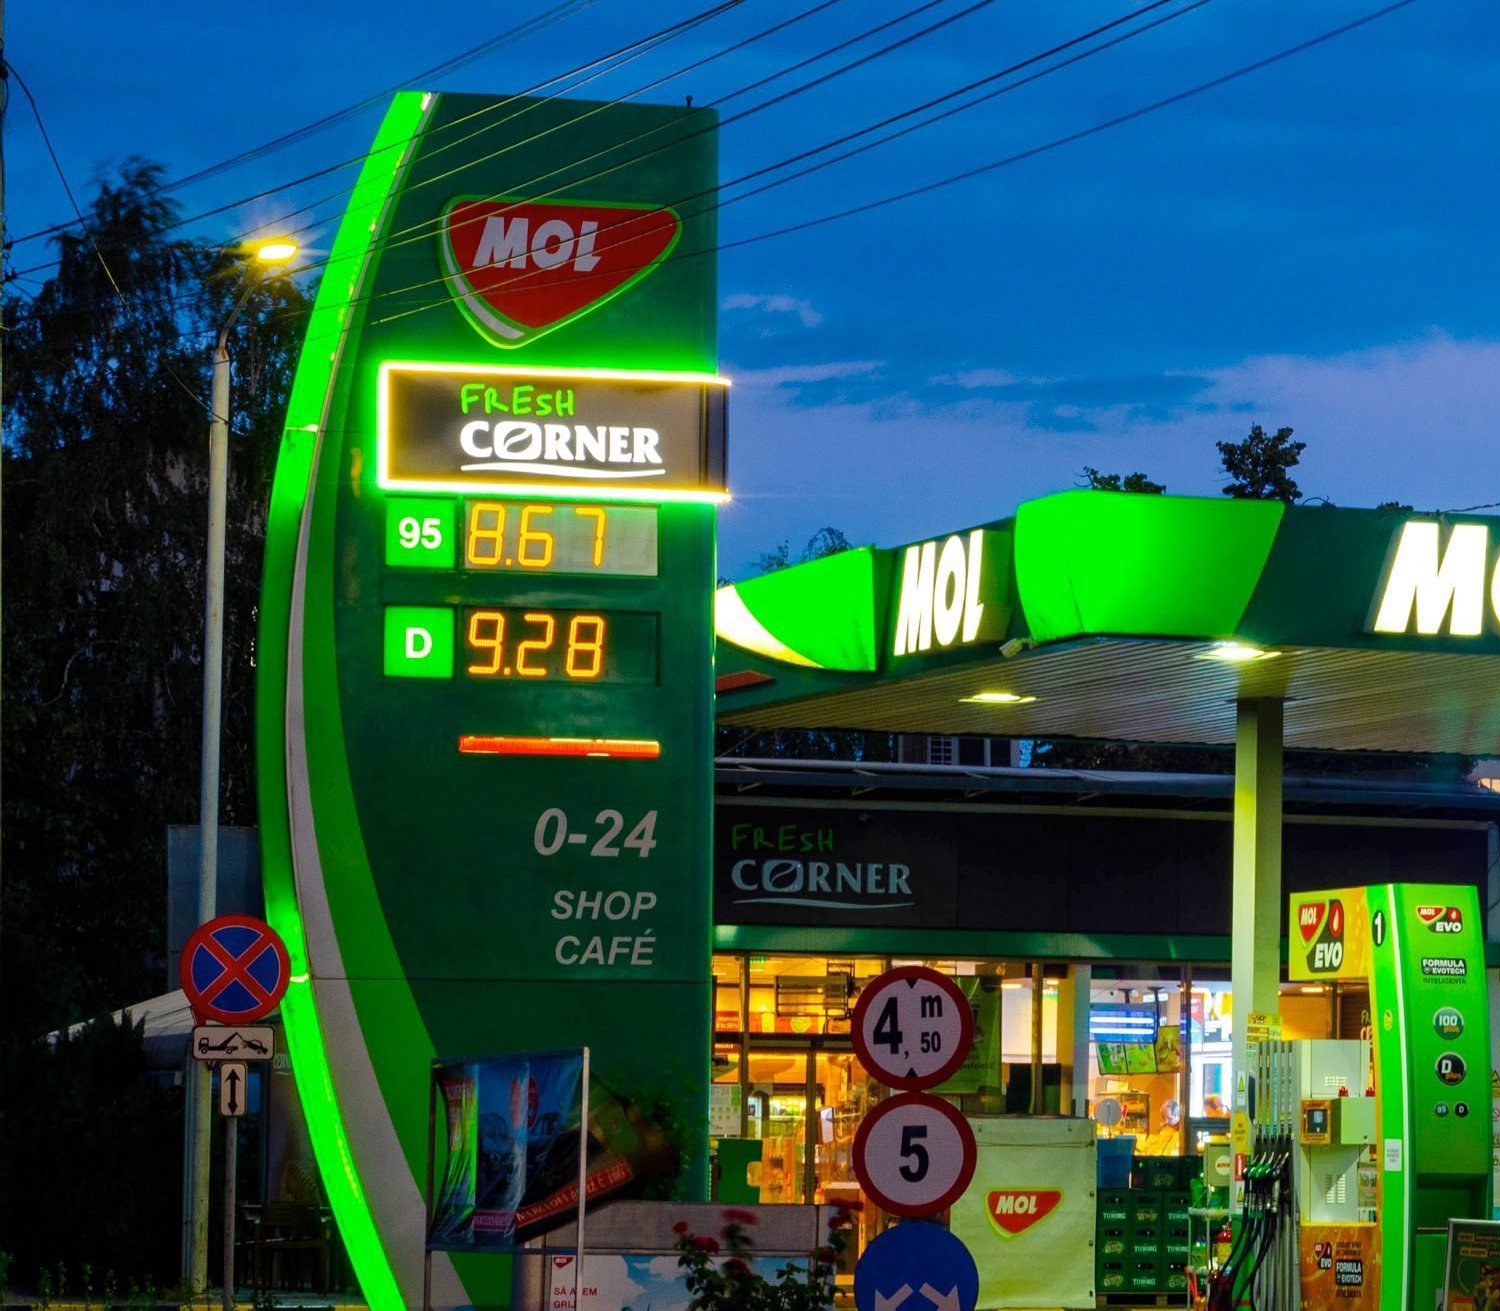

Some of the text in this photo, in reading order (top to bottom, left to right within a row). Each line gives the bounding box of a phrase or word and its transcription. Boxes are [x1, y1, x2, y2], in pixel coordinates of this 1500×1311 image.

[472, 215, 602, 272] MOL
[461, 383, 575, 417] FRESH
[460, 420, 663, 464] CORNER
[398, 517, 442, 550] 95
[467, 502, 608, 567] 8.67
[893, 529, 986, 656] MOL
[405, 627, 433, 659] D
[468, 611, 605, 678] 9.28
[534, 807, 658, 858] 0-24
[731, 823, 834, 853] FRESH
[731, 858, 912, 895] CORNER
[551, 890, 657, 920] SHOP
[1300, 907, 1317, 926] MOL
[1420, 907, 1436, 916] MOL
[1374, 911, 1382, 945] 1
[1435, 921, 1462, 932] EVO
[555, 928, 656, 966] CAFÉ
[1314, 942, 1343, 969] EVO
[1422, 958, 1464, 968] FORMULA
[1432, 967, 1466, 975] EVOTECH
[1439, 1015, 1458, 1026] 100
[1441, 1060, 1452, 1074] D
[1458, 1105, 1465, 1114] D
[898, 1125, 930, 1184] 5
[995, 1195, 1038, 1215] MOL
[1103, 1212, 1126, 1220] TUBORG
[1320, 1258, 1332, 1268] EVO
[1336, 1261, 1362, 1273] FORMULA
[570, 1287, 598, 1296] AEM
[1133, 1278, 1156, 1286] TUBORG
[1341, 1273, 1362, 1283] EVOTECH
